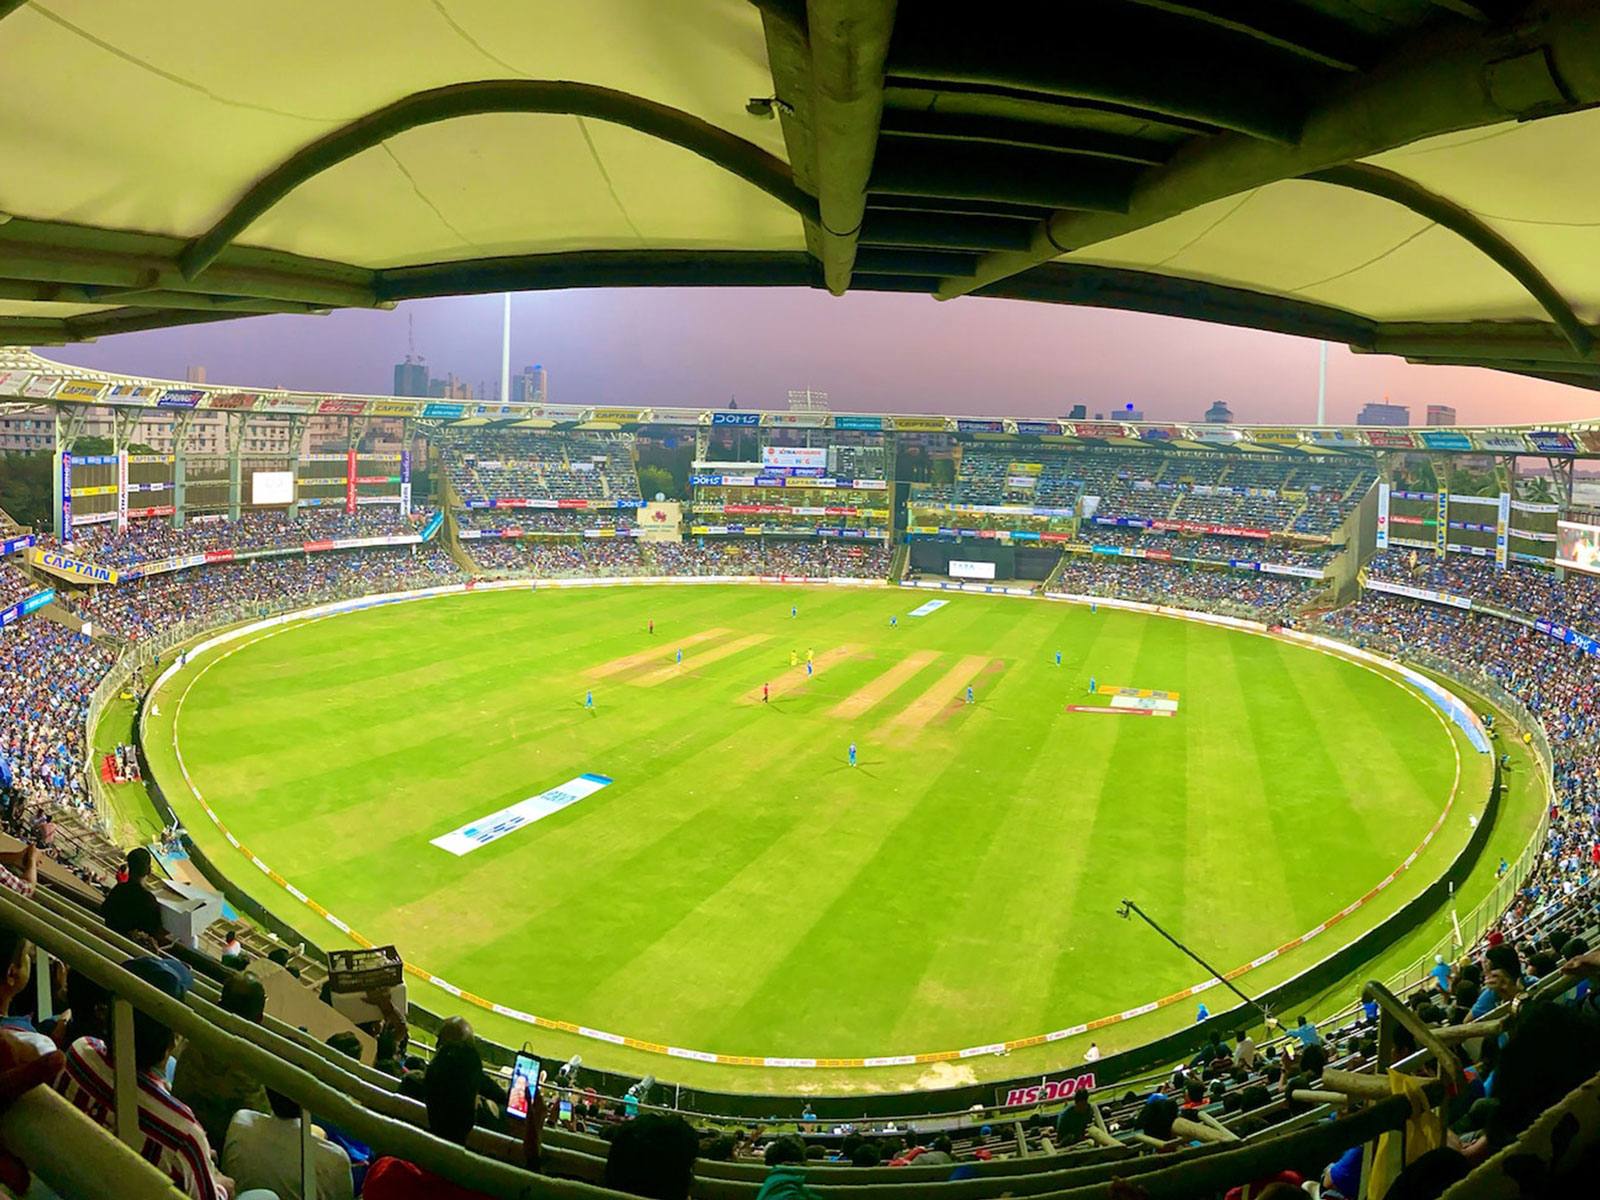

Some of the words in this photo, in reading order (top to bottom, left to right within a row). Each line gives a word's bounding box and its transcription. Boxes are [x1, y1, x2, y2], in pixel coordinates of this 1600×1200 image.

[714, 414, 758, 424] DOMS
[693, 475, 721, 484] DOMS
[1438, 492, 1447, 560] CAPTAIN
[43, 554, 110, 581] CAPTAIN
